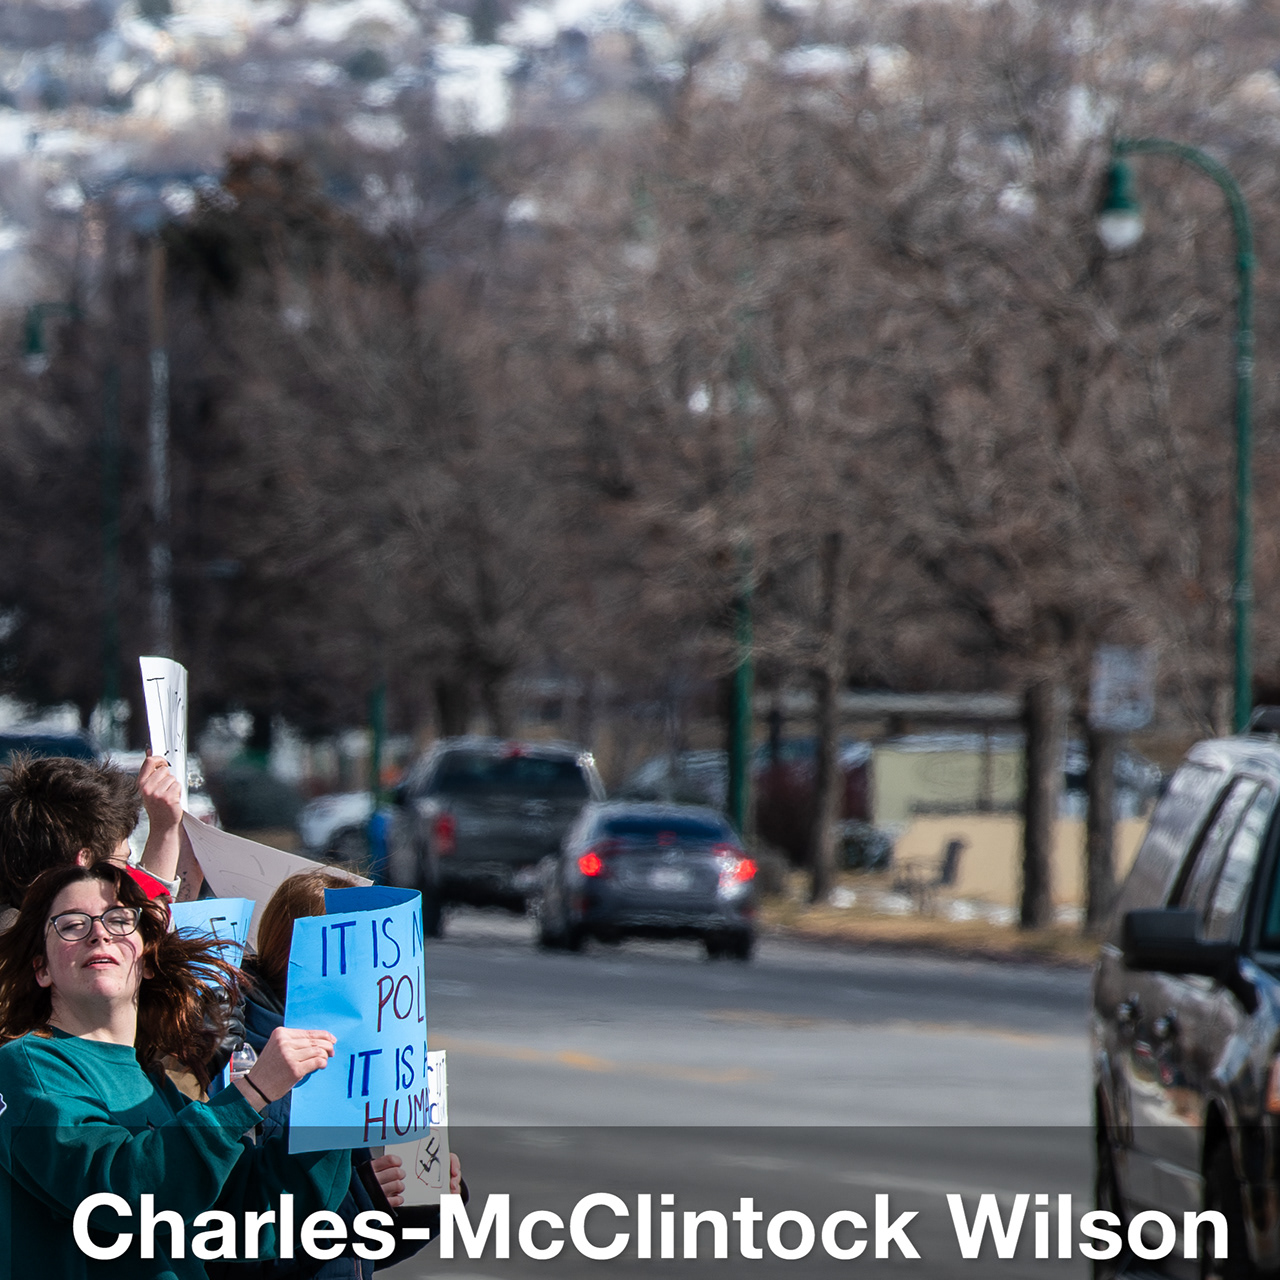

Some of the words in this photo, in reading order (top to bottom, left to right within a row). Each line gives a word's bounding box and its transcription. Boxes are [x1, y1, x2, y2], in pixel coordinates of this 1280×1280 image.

[321, 920, 357, 977] IT
[372, 917, 401, 968] IS
[347, 1048, 383, 1098] IT
[396, 1045, 415, 1091] IS
